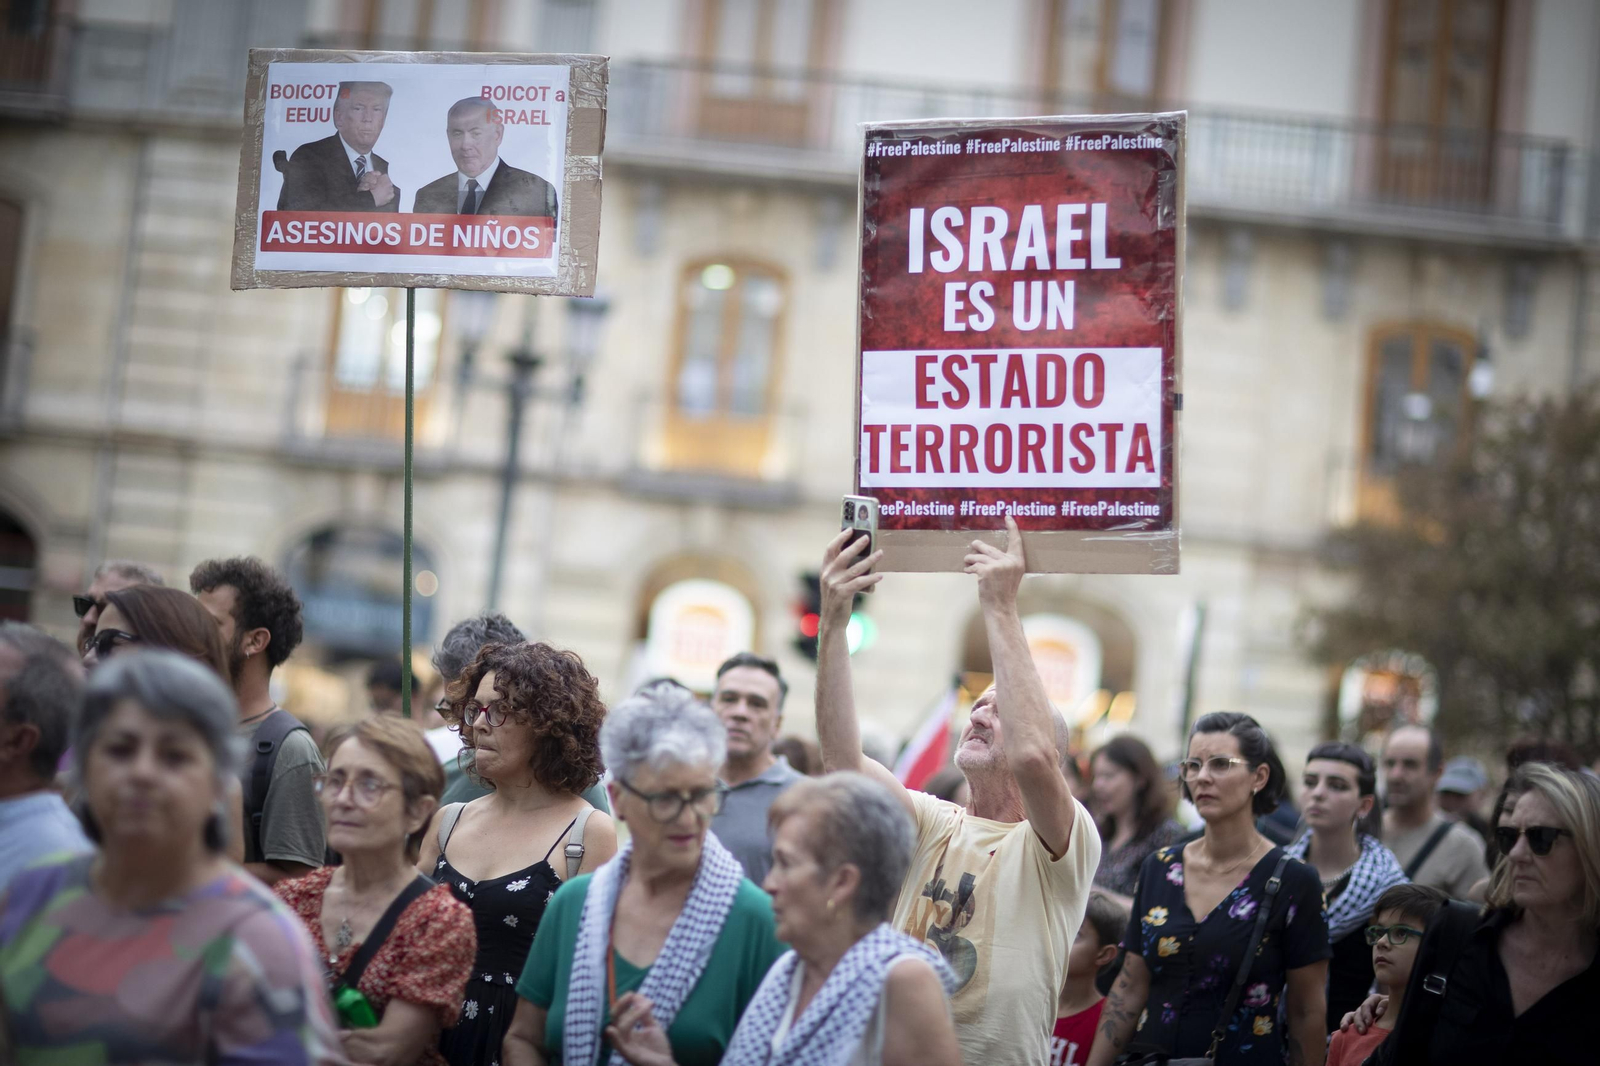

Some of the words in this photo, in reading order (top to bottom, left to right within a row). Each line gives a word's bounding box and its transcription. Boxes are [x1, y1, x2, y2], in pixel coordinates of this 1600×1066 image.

[270, 83, 337, 99] BOICOT
[481, 85, 551, 101] BOICOT
[555, 90, 565, 102] a
[285, 107, 331, 123] EEUU
[486, 108, 551, 125] ISRAEL
[867, 140, 961, 157] #FreePalestine
[965, 137, 1061, 154] #FreePalestine
[1065, 134, 1163, 151] #FreePalestine
[266, 220, 402, 246] ASESINOS
[409, 223, 445, 247] DE
[452, 219, 540, 250] NIÑOS
[908, 203, 1121, 273] ISRAEL
[943, 281, 996, 332] ES
[1012, 280, 1075, 331] UN
[915, 353, 1106, 410] ESTADO
[863, 422, 1156, 474] TERRORISTA
[878, 500, 955, 516] eePalestine
[960, 500, 1056, 517] #FreePalestine
[1061, 501, 1160, 517] #FreePalestine
